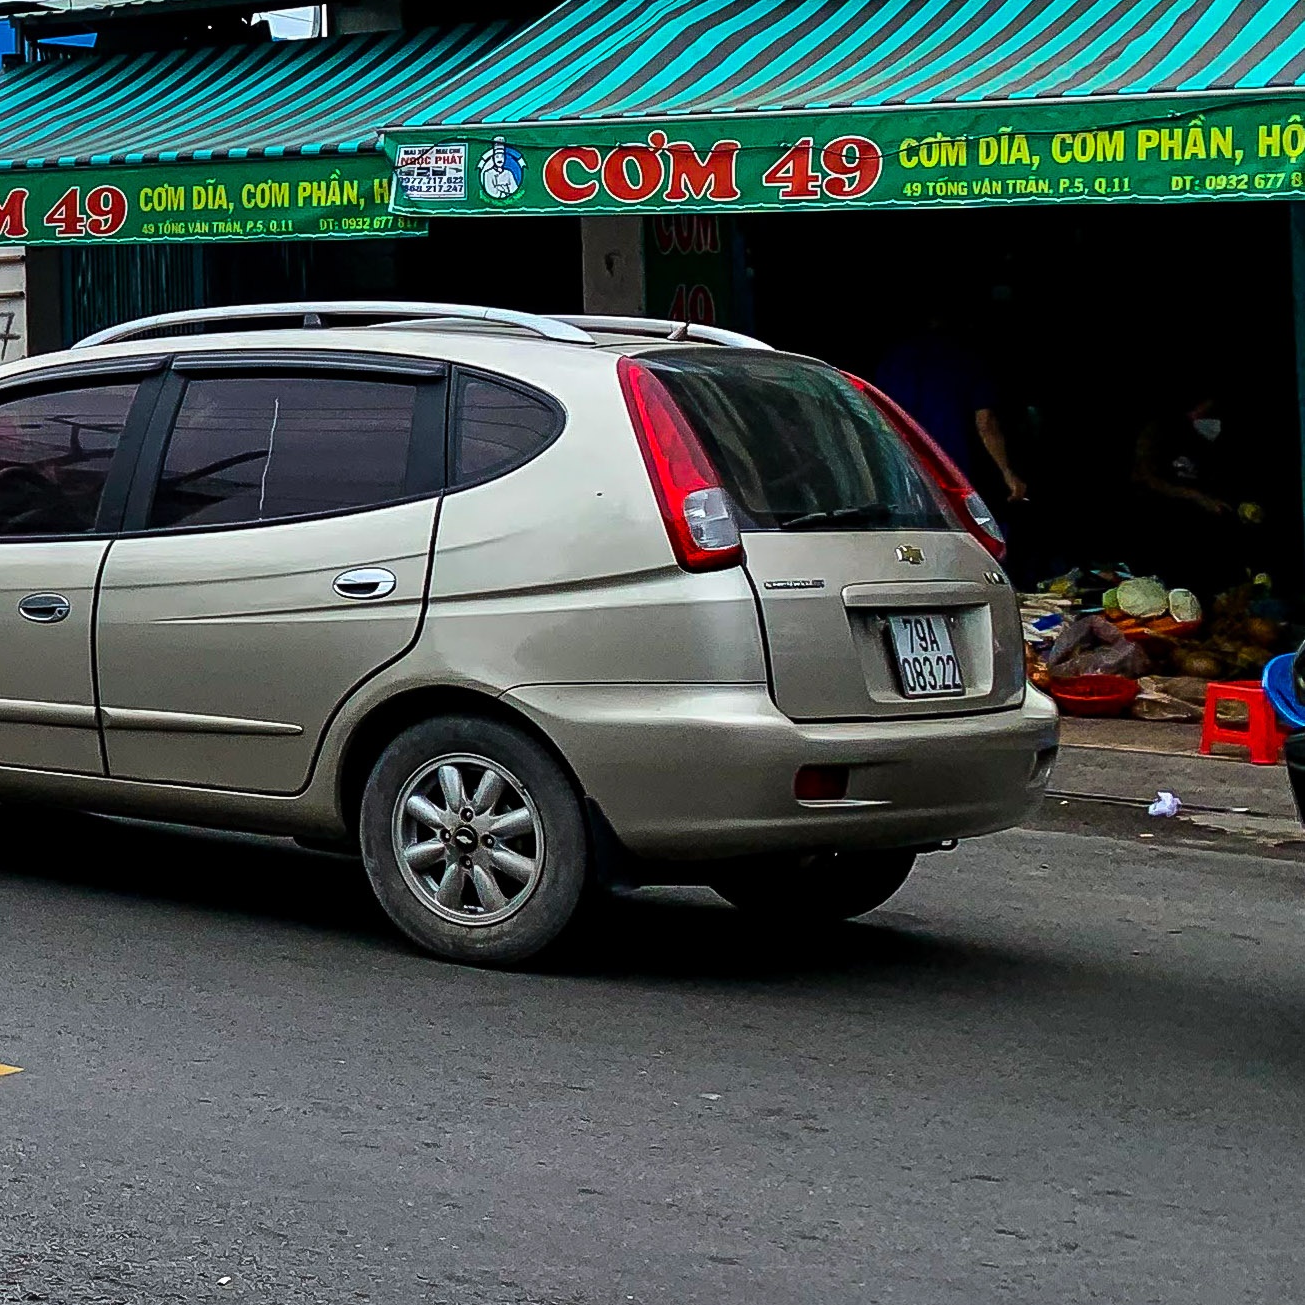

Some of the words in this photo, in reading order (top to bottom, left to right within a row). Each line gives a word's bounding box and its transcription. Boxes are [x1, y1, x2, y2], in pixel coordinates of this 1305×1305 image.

[899, 131, 967, 168] CƠM
[978, 127, 1040, 170] DĨA,
[1052, 128, 1125, 164] CƠM
[1138, 113, 1245, 166] PHẦN,
[543, 130, 742, 204] CƠM
[763, 135, 884, 201] 49
[902, 181, 923, 197] 49
[1094, 176, 1131, 193] Q.11
[1205, 174, 1249, 190] 0932
[1254, 172, 1286, 189] 677
[43, 184, 128, 237] 49
[139, 181, 186, 213] CƠM
[192, 178, 235, 215] DĨA,
[242, 178, 290, 209] CƠM
[297, 169, 366, 212] PHẦN,
[142, 223, 155, 235] 49
[269, 219, 293, 233] Q.11
[341, 216, 370, 230] 0932
[374, 216, 393, 229] 677
[901, 617, 941, 654] 79A
[901, 655, 963, 692] 083.22
